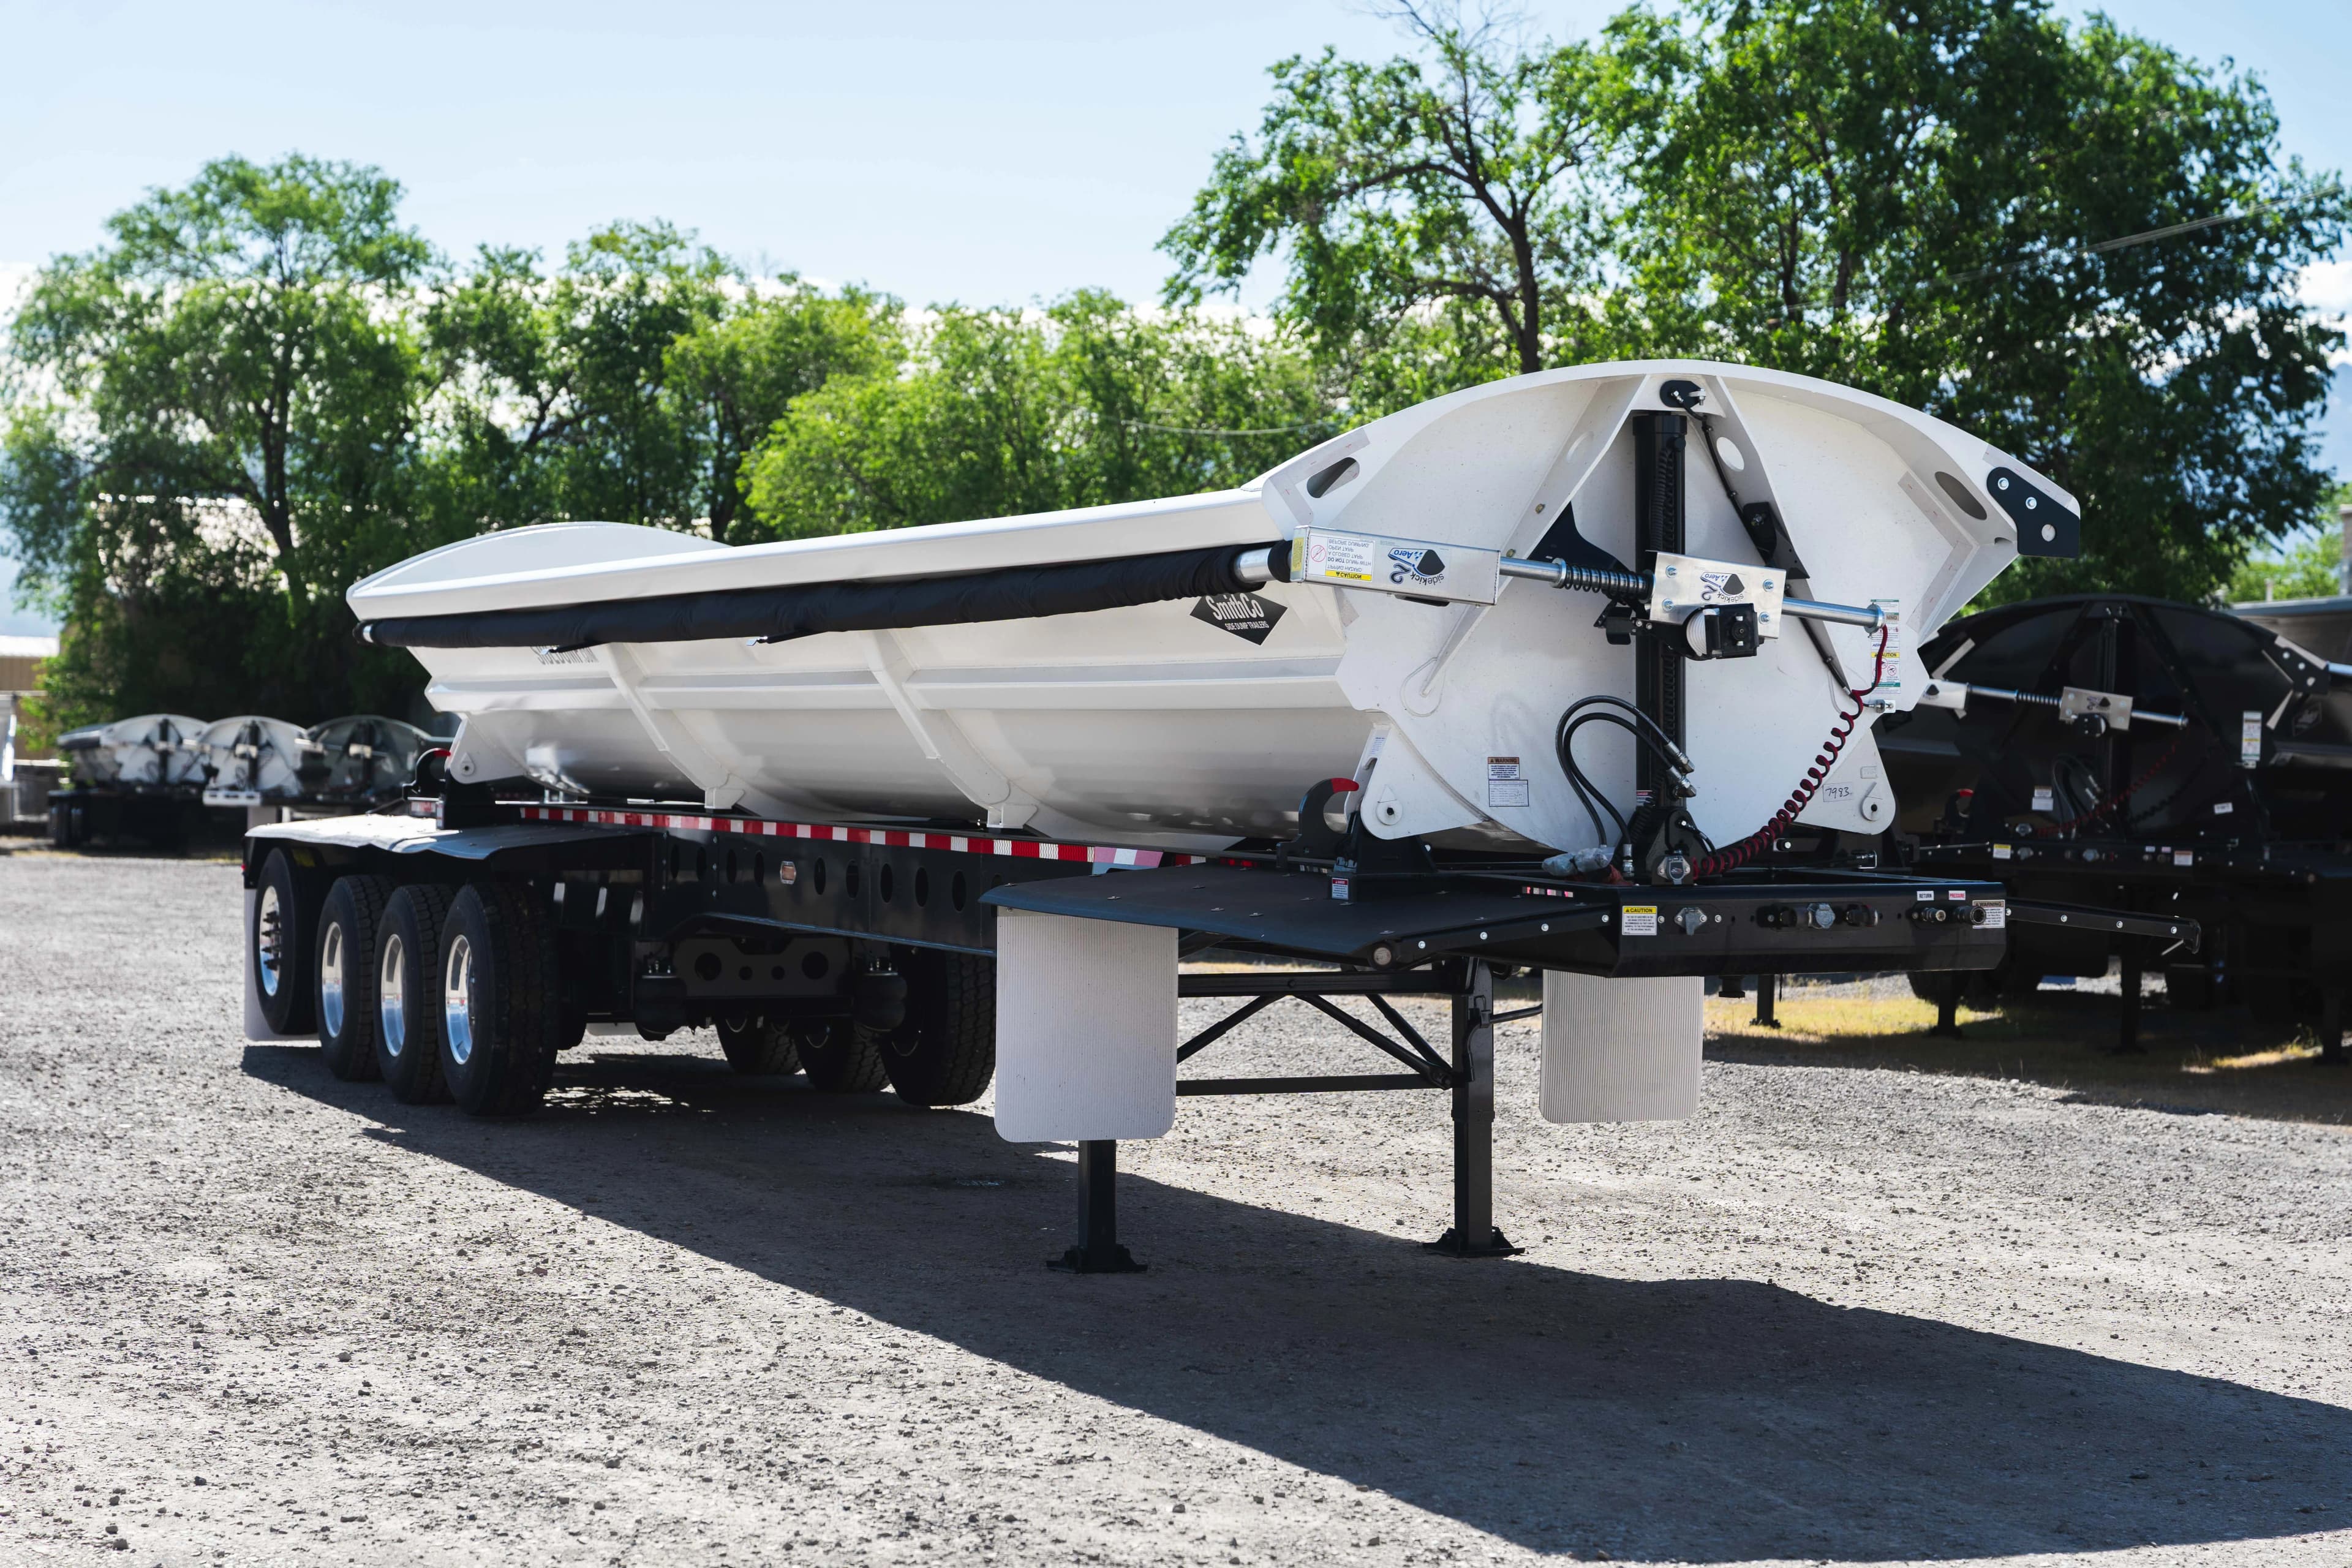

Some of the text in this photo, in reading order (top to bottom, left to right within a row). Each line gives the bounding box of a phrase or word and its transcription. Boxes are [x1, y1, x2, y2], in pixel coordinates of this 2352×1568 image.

[1393, 549, 1414, 559] Aero
[1390, 562, 1411, 584] 2
[1410, 571, 1444, 586] sidekick
[1701, 584, 1717, 601] 2
[1717, 592, 1744, 603] sidekick
[1205, 592, 1264, 620] SmithCo
[1246, 620, 1270, 629] TRAILERS
[1825, 786, 1849, 799] 7983
